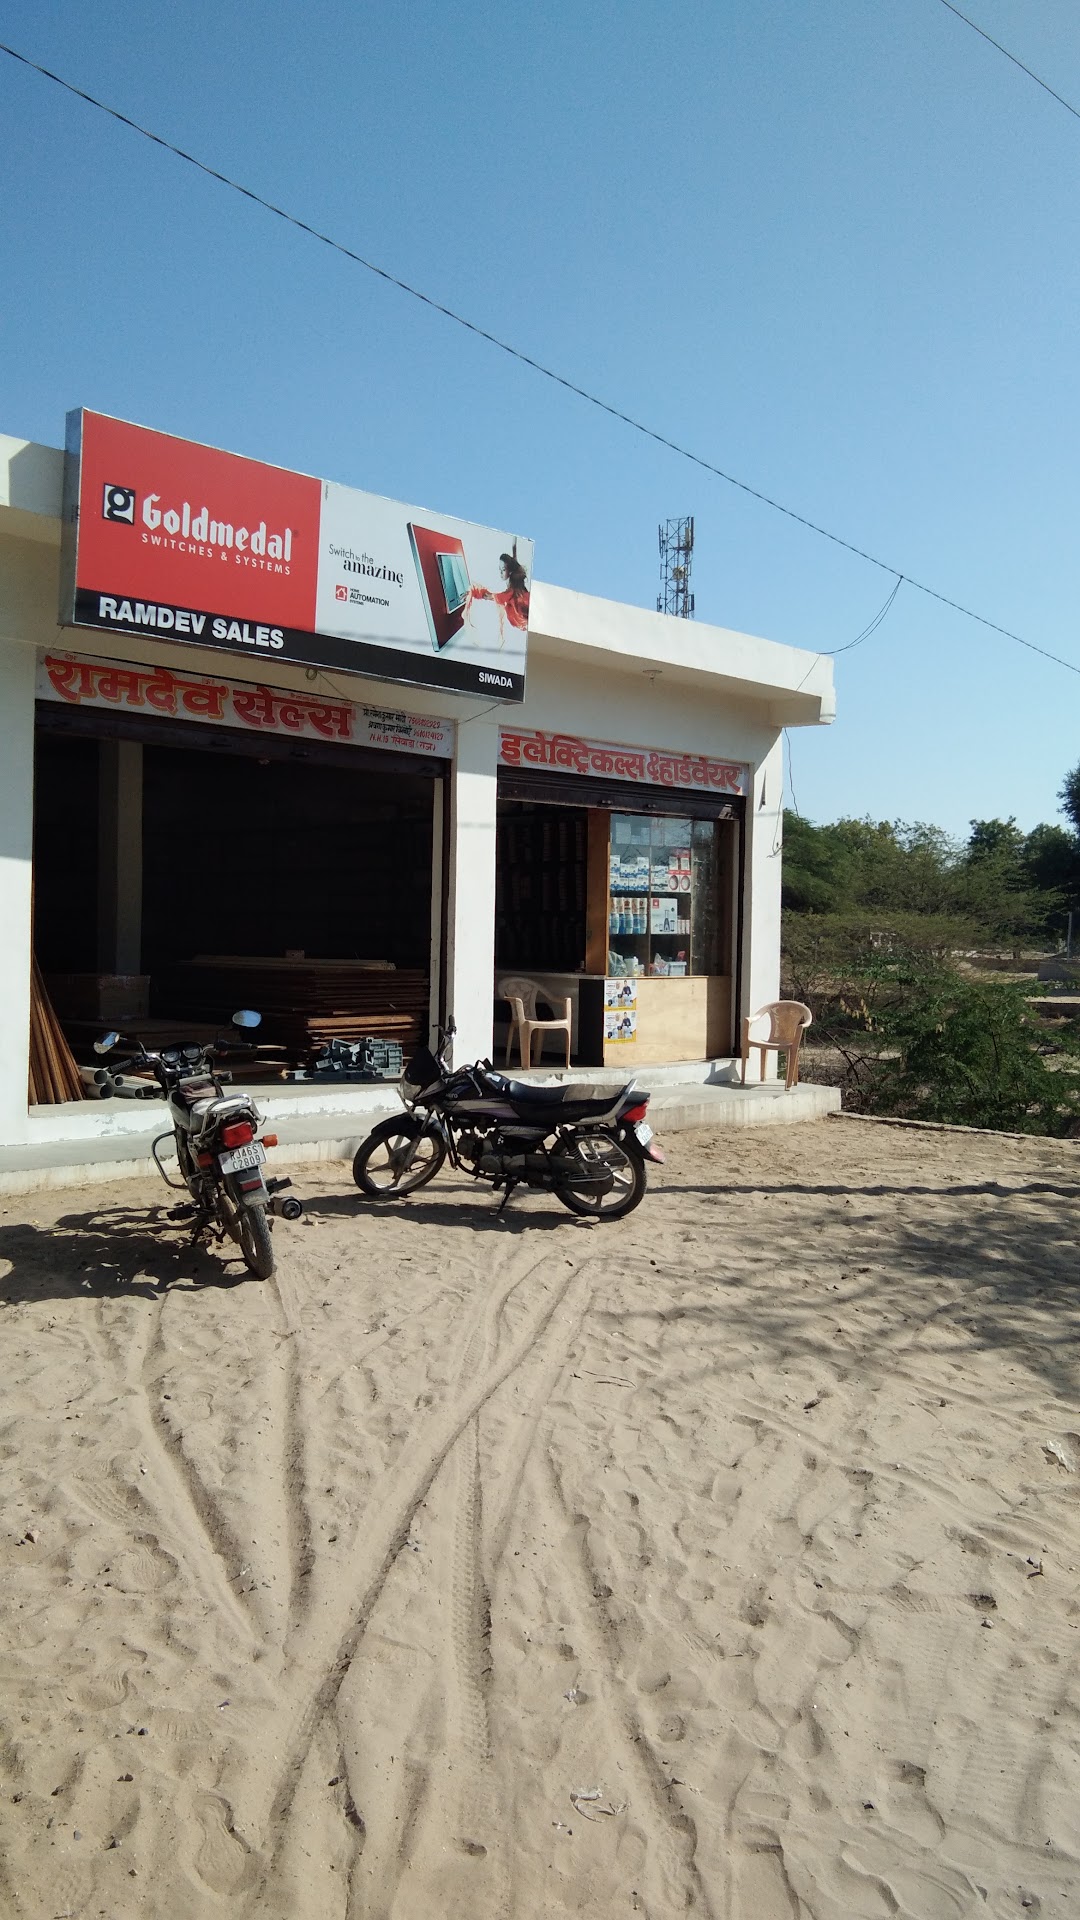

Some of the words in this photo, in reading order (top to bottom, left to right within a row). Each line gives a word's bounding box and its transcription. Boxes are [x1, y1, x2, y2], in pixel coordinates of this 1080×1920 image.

[142, 493, 292, 562] Goldmedal
[141, 533, 213, 558] SWITCHES
[220, 551, 228, 562] &
[235, 554, 291, 576] SYSTEMS
[329, 543, 355, 560] Switch
[361, 552, 374, 565] the
[343, 559, 404, 588] amazing
[350, 592, 390, 607] AUTOMATION
[98, 596, 206, 635] RAMDEV
[212, 618, 285, 650] SALES
[44, 655, 228, 719] रामदेव
[232, 685, 354, 738] सेल्स
[478, 671, 513, 689] SIWADA
[499, 732, 646, 780] इलेक्ट्रिकल्स
[659, 755, 742, 793] हार्डवेयर
[229, 1144, 259, 1161] RJ46S
